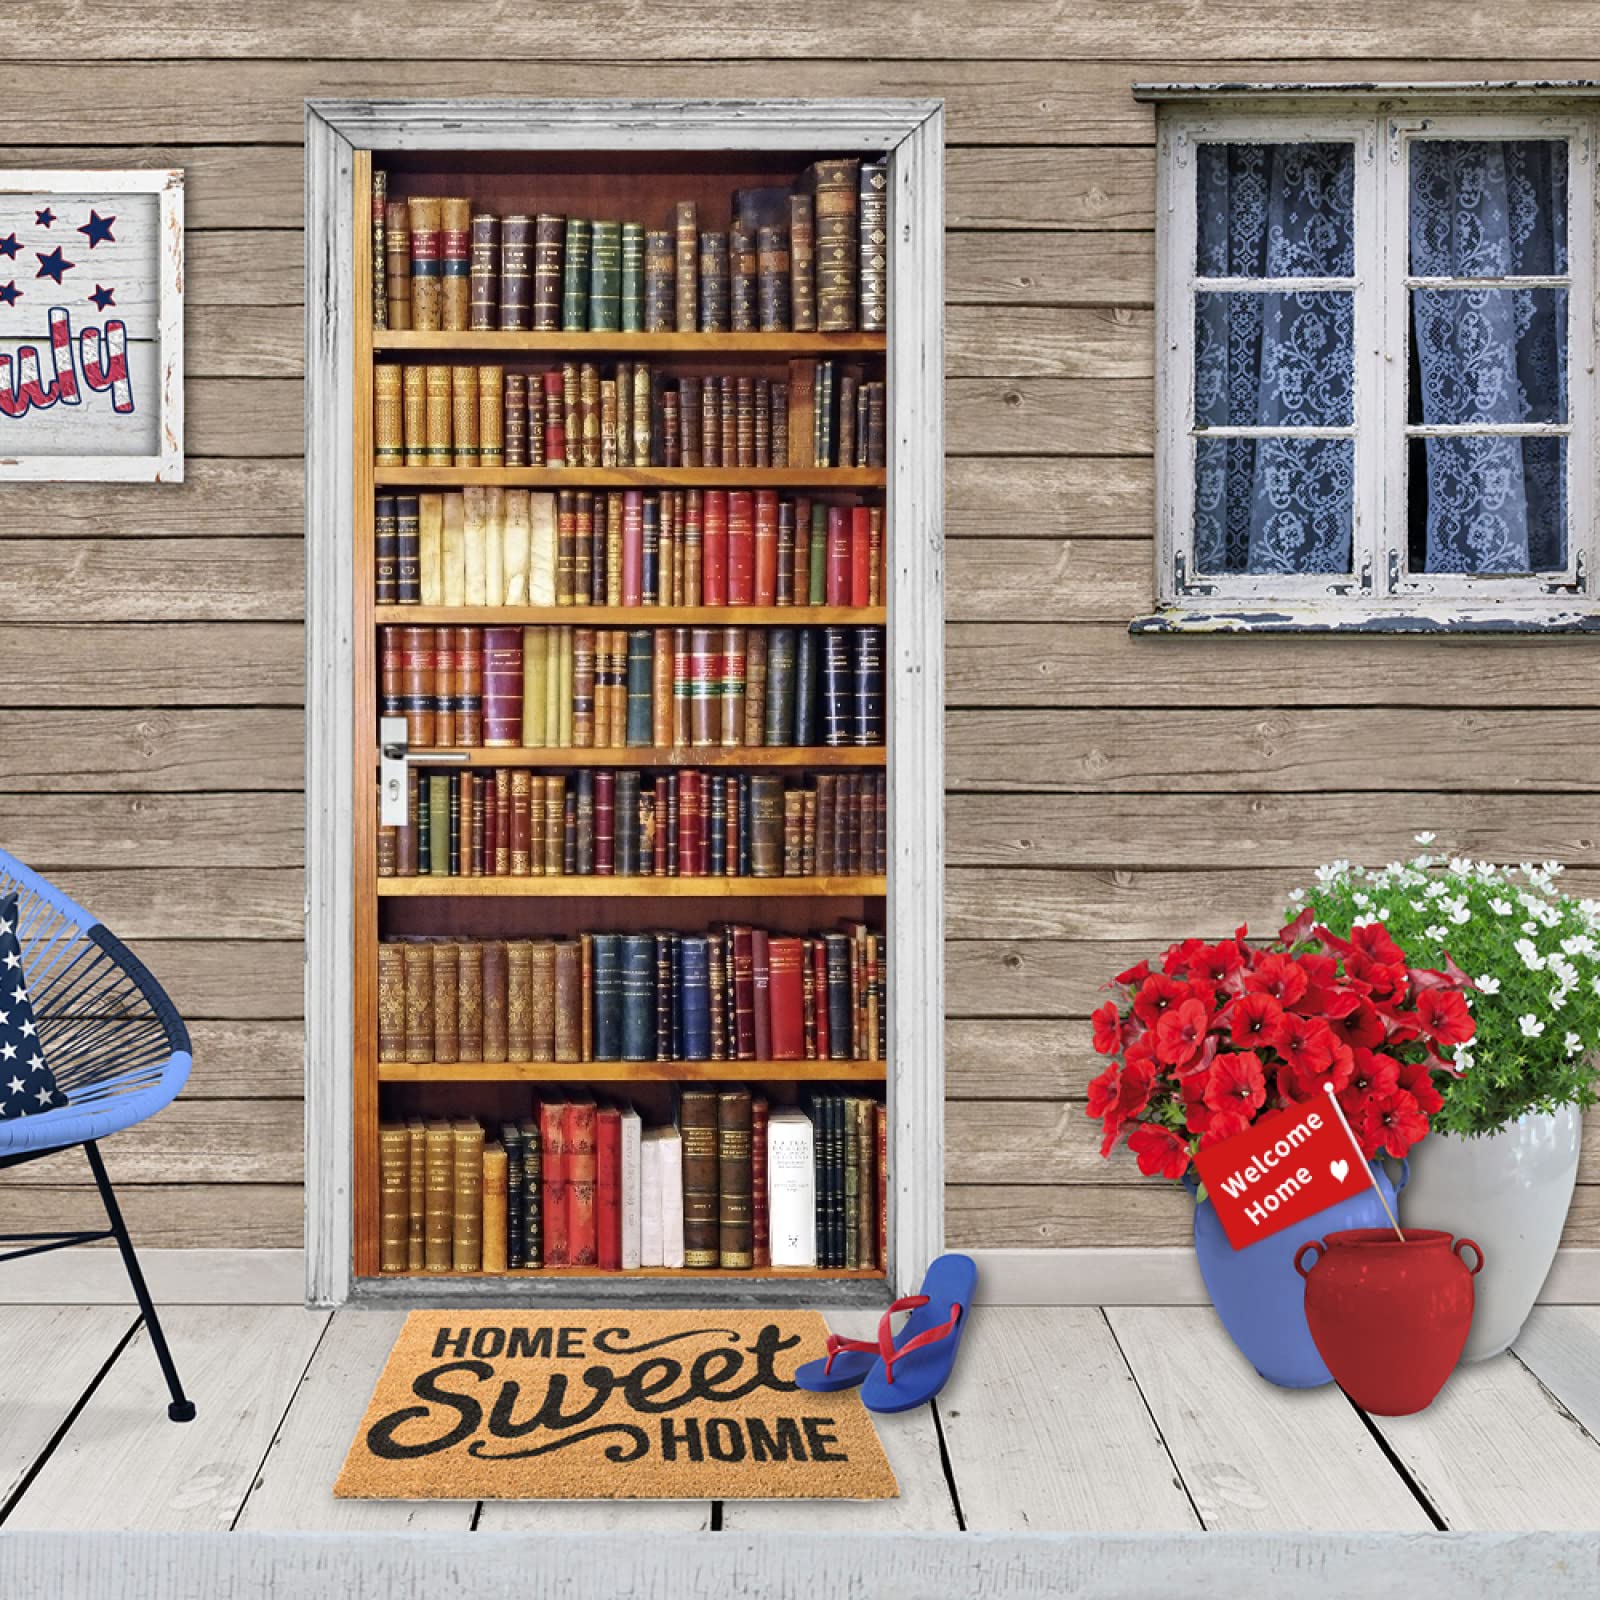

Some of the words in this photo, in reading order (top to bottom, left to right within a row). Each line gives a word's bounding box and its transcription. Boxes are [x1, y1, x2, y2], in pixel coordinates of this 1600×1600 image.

[0, 307, 134, 418] uly
[1220, 1112, 1324, 1199] Welcome
[1243, 1167, 1313, 1226] Home
[431, 1327, 587, 1359] HOME
[367, 1324, 802, 1460] Sweet
[660, 1417, 849, 1463] HOME
